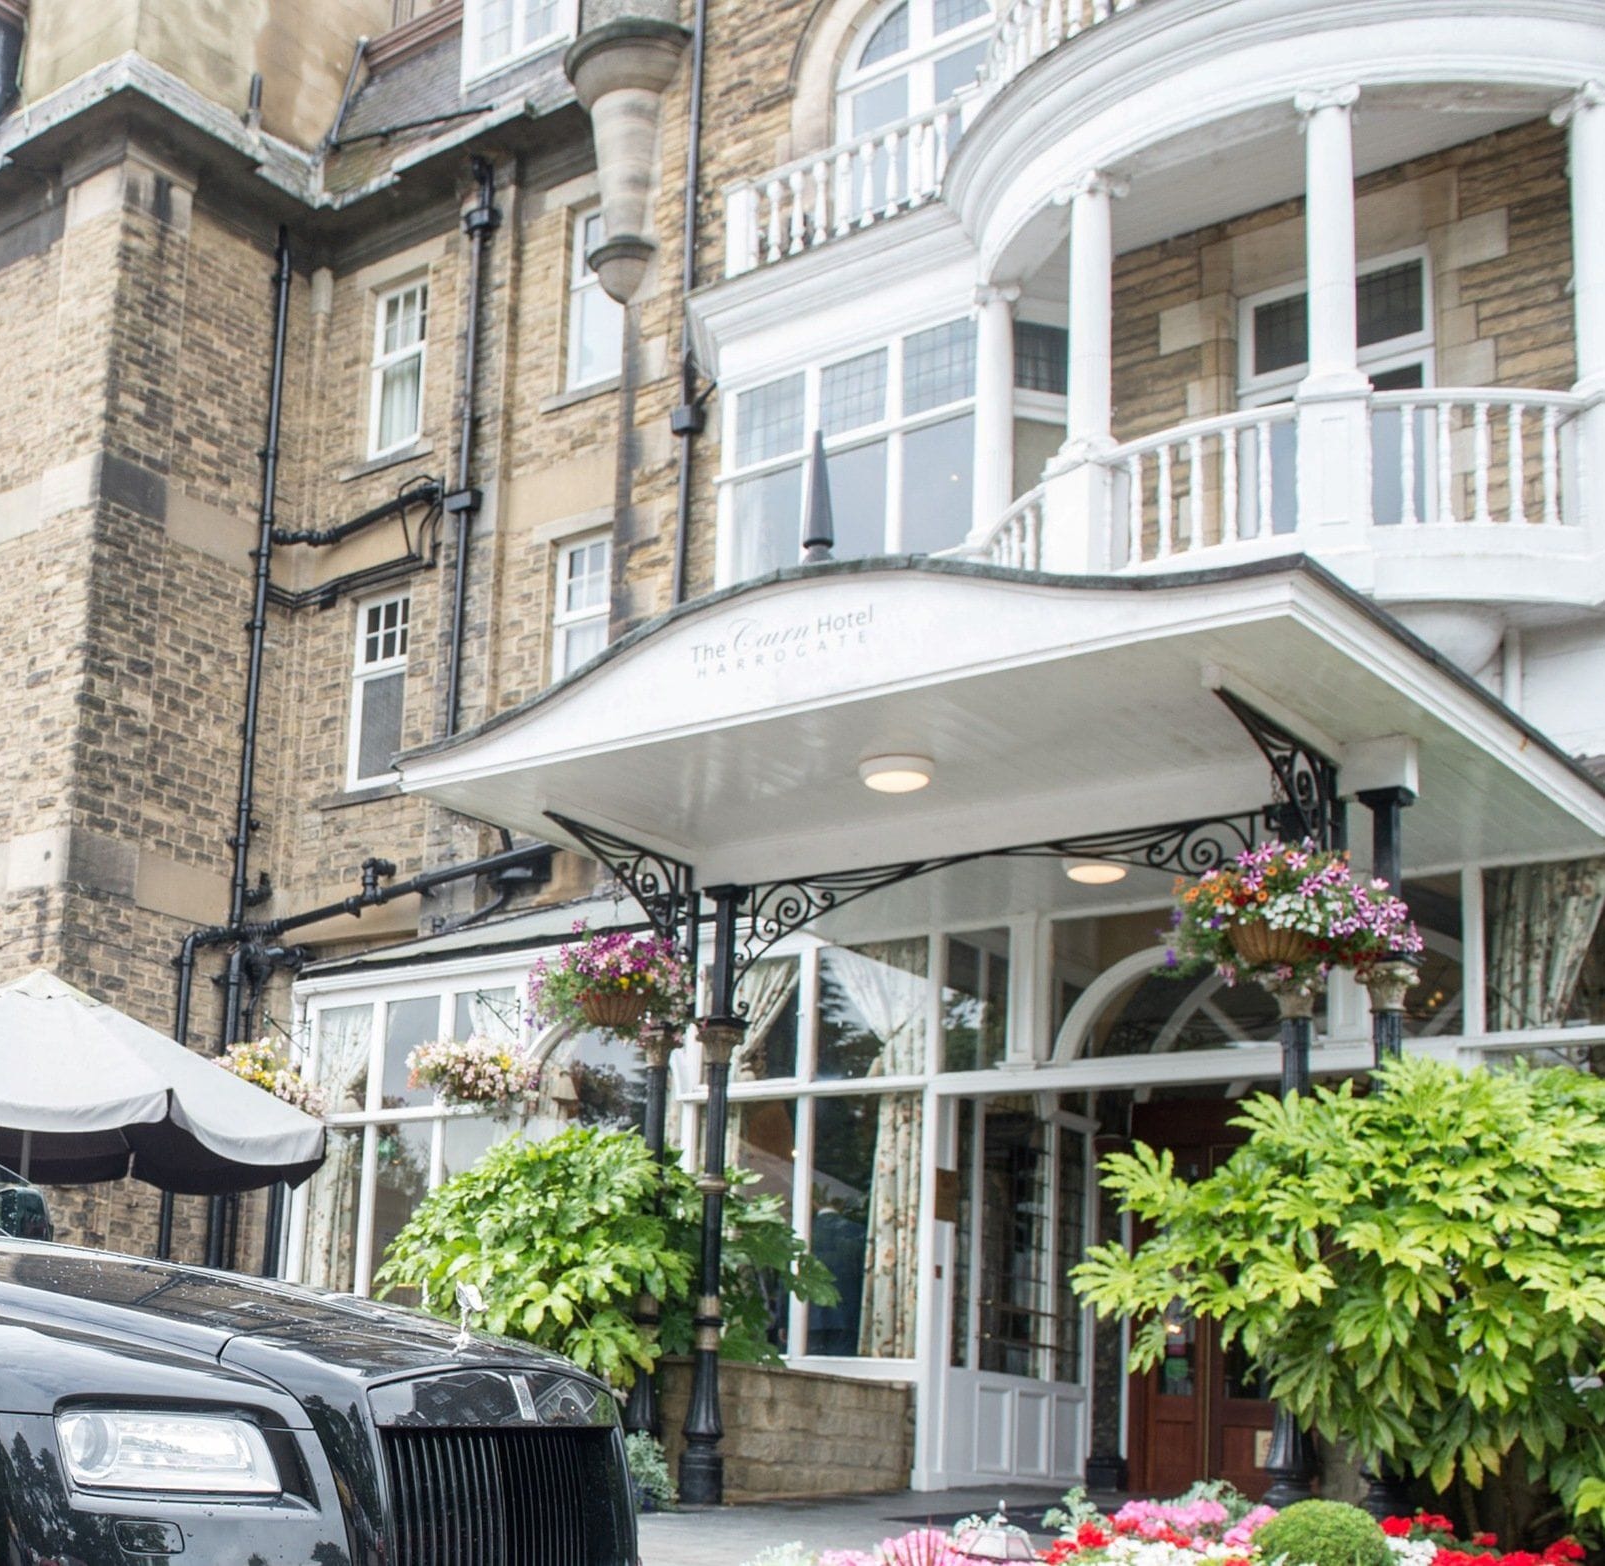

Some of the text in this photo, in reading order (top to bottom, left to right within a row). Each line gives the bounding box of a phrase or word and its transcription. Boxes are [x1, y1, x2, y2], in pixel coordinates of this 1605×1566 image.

[690, 642, 727, 664] The
[816, 603, 874, 635] Hotel
[696, 630, 867, 680] HARROGATE
